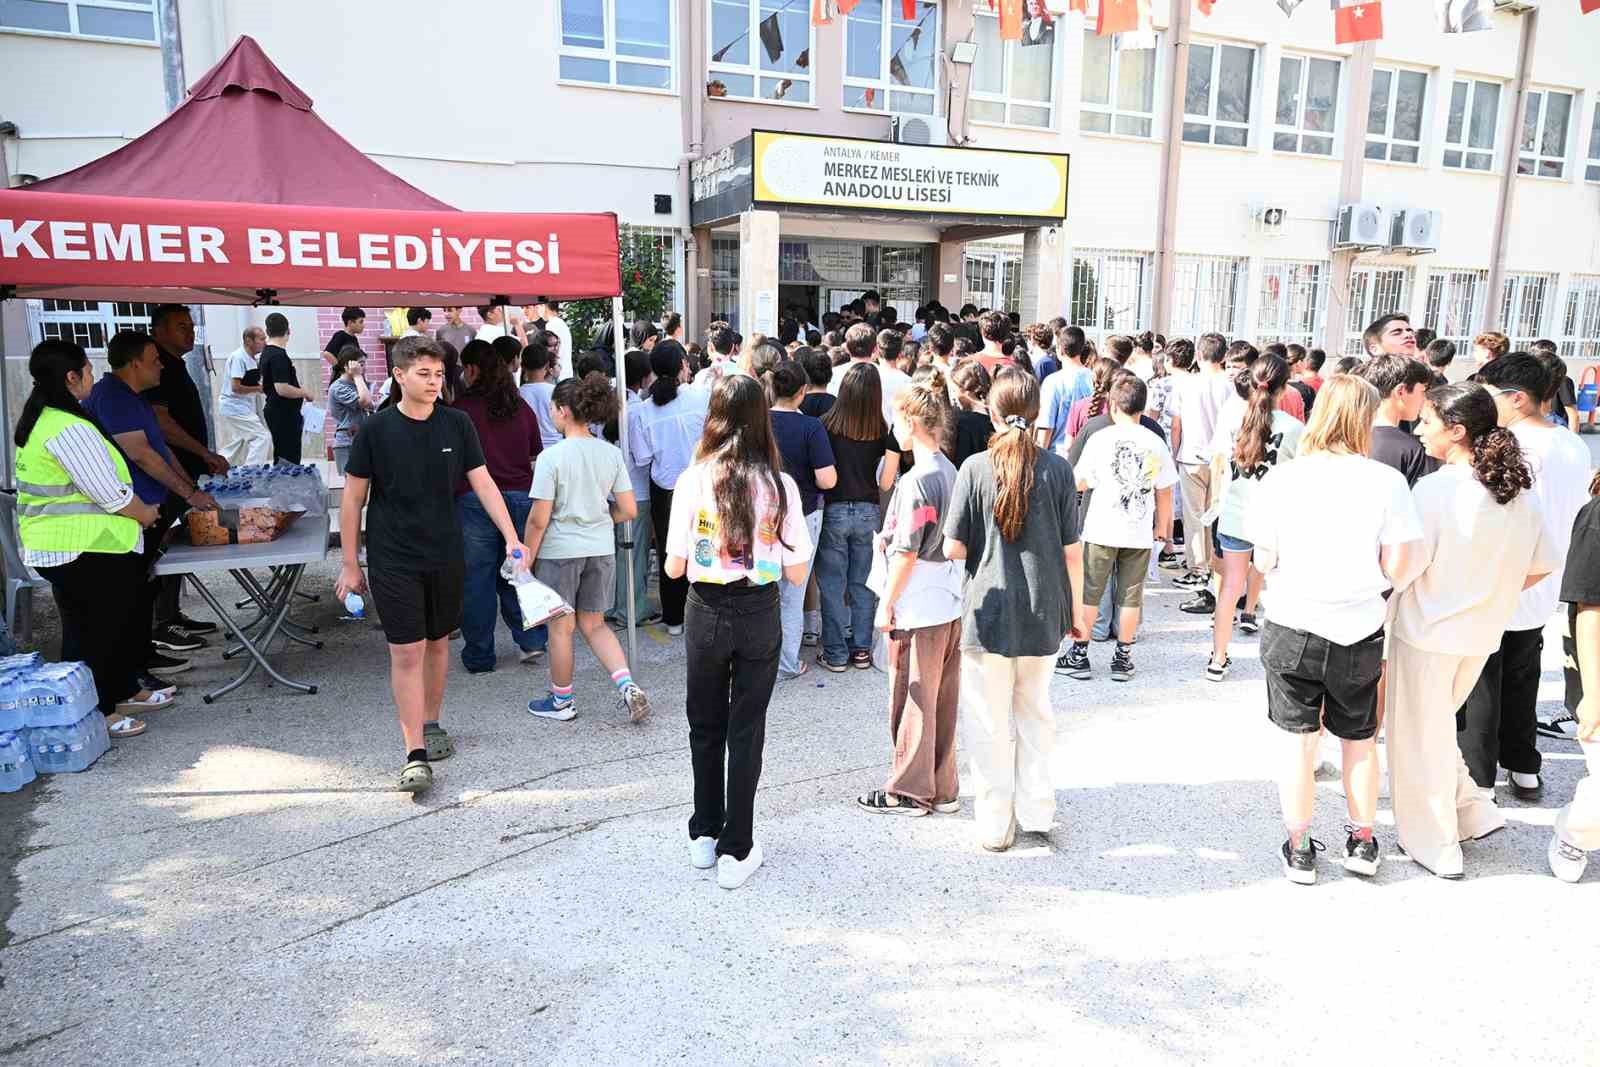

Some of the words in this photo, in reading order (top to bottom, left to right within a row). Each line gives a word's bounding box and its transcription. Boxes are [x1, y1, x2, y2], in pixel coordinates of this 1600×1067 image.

[823, 146, 862, 159] ANTALYA
[870, 150, 900, 162] KEMER
[824, 161, 878, 179] MERKEZ
[881, 166, 935, 184] MESLEKİ
[938, 171, 953, 184] VE
[956, 170, 1000, 187] TEKNİK
[823, 182, 903, 200] ANADOLU
[907, 186, 951, 203] LİSESİ
[0, 219, 229, 264] KEMER
[249, 227, 561, 275] BELEDİYESİ
